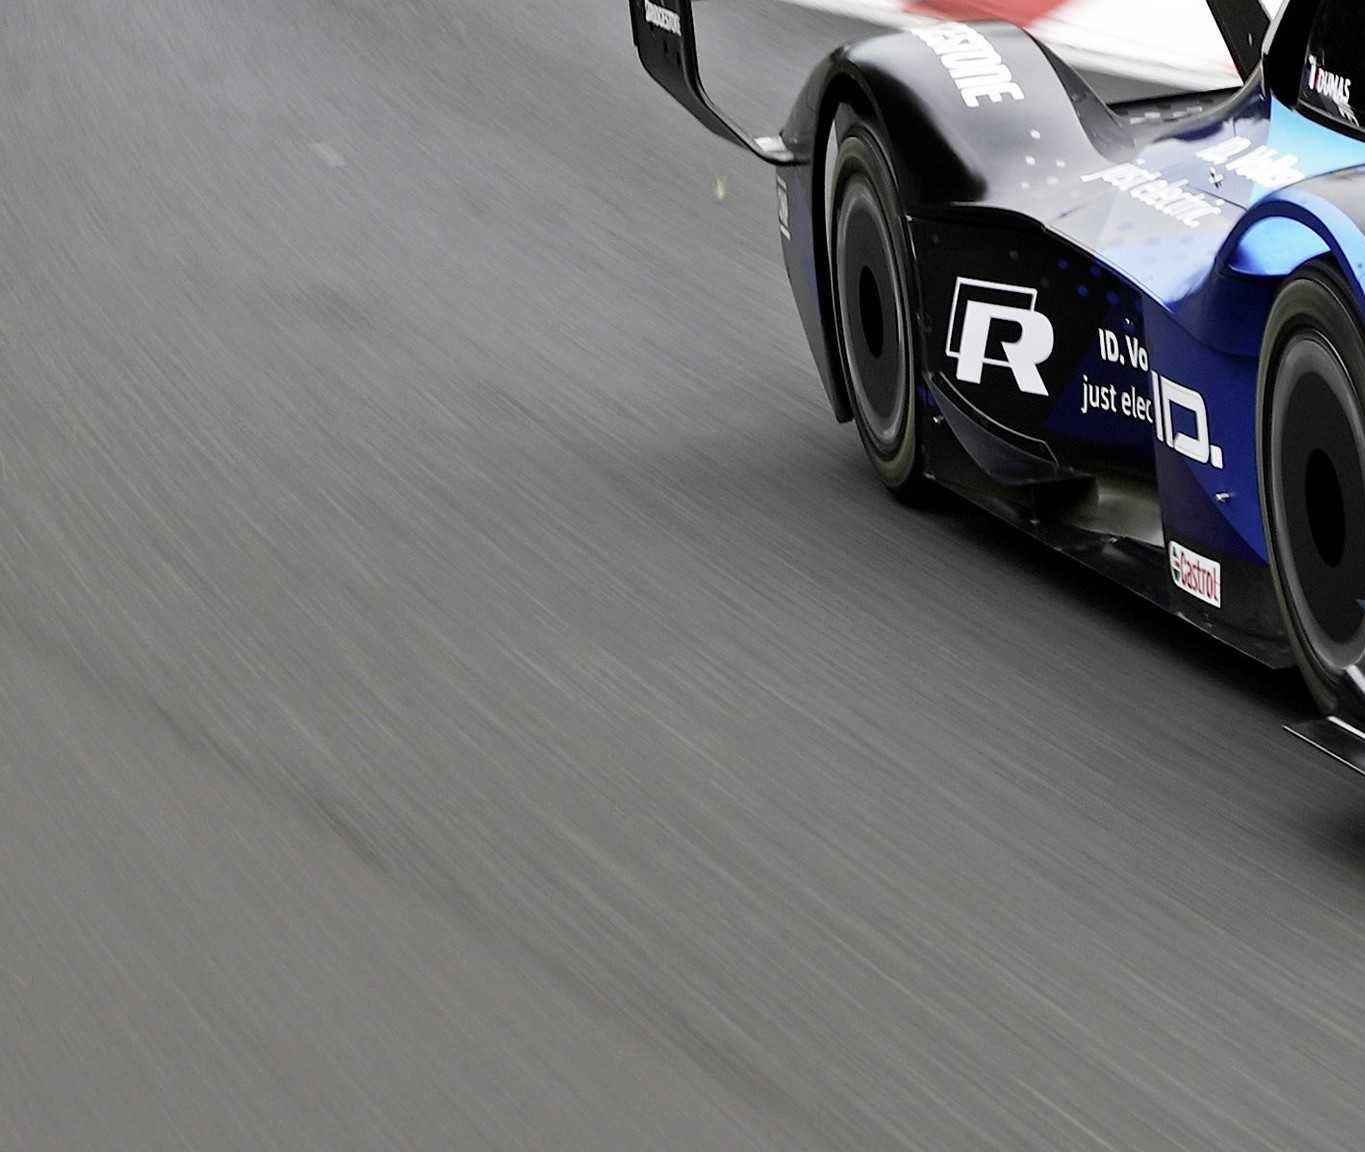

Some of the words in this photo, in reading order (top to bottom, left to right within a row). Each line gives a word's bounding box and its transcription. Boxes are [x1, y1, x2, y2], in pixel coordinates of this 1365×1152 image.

[955, 300, 1055, 397] R
[1098, 328, 1125, 366] ID.
[1081, 374, 1117, 414] just
[1121, 386, 1154, 424] elec
[1150, 369, 1224, 470] ID.
[1180, 551, 1219, 602] Castrol
